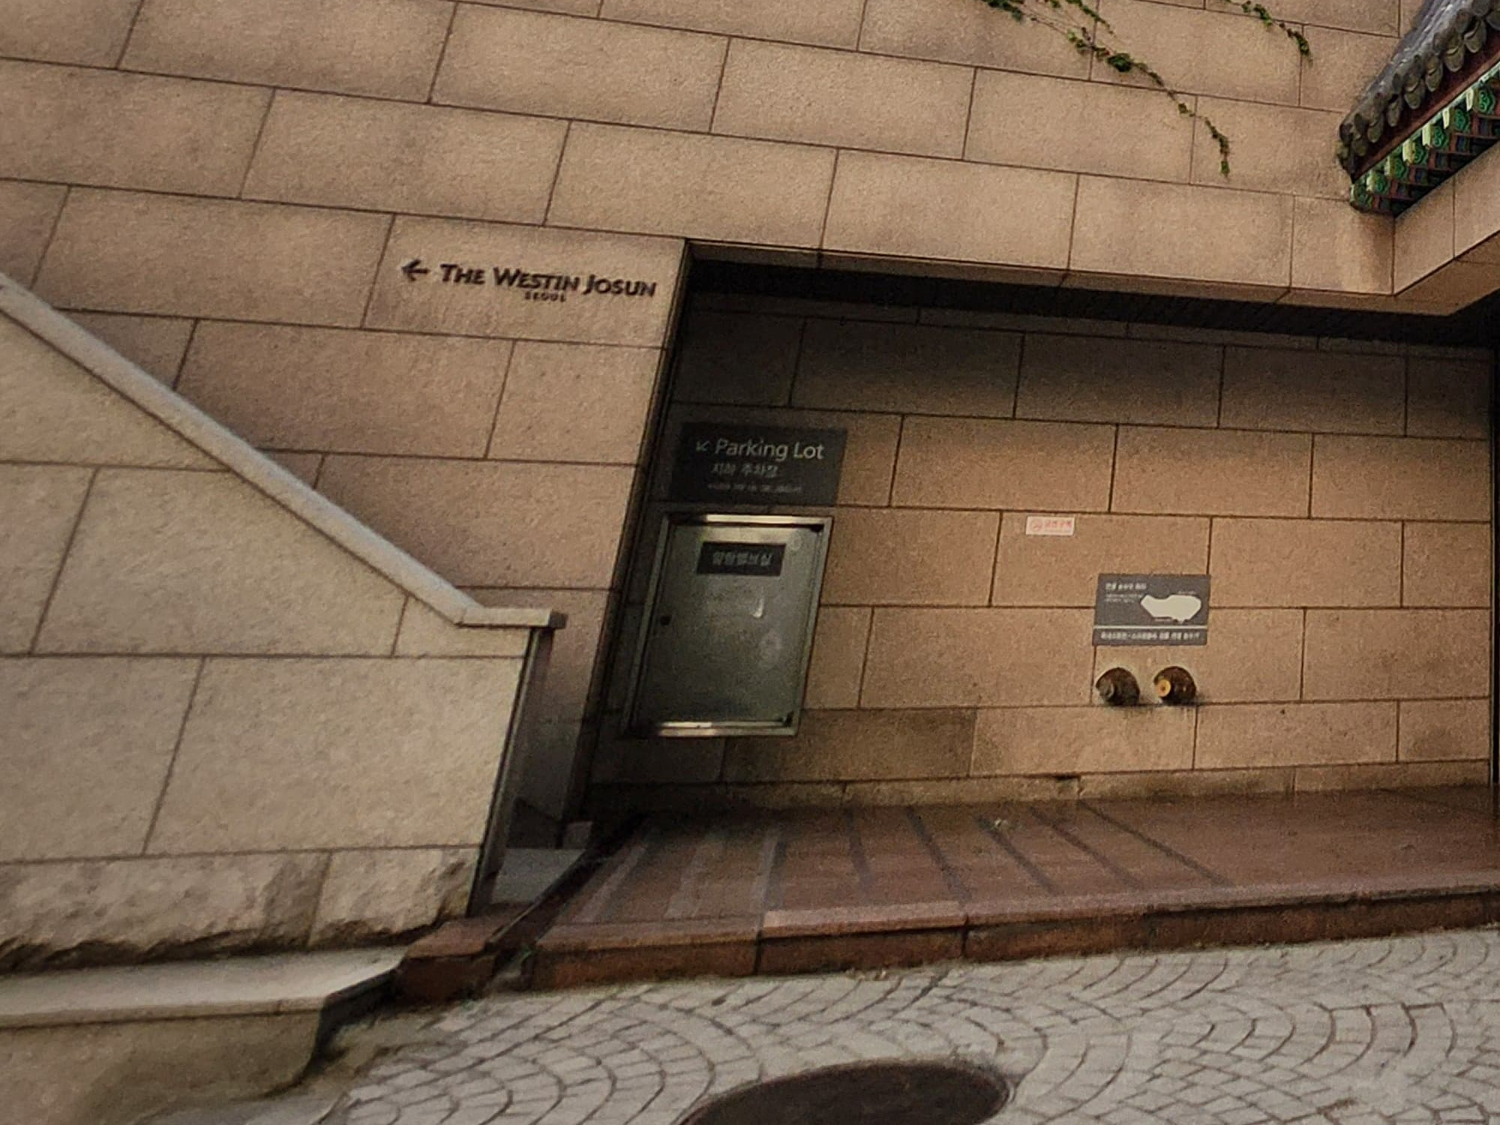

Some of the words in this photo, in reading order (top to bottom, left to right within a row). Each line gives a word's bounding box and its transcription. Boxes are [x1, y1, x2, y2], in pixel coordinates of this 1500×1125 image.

[440, 263, 485, 285] THE
[493, 266, 580, 291] WESTIN
[583, 273, 657, 297] JOSUN
[714, 437, 788, 462] Parking
[793, 440, 826, 460] Lot
